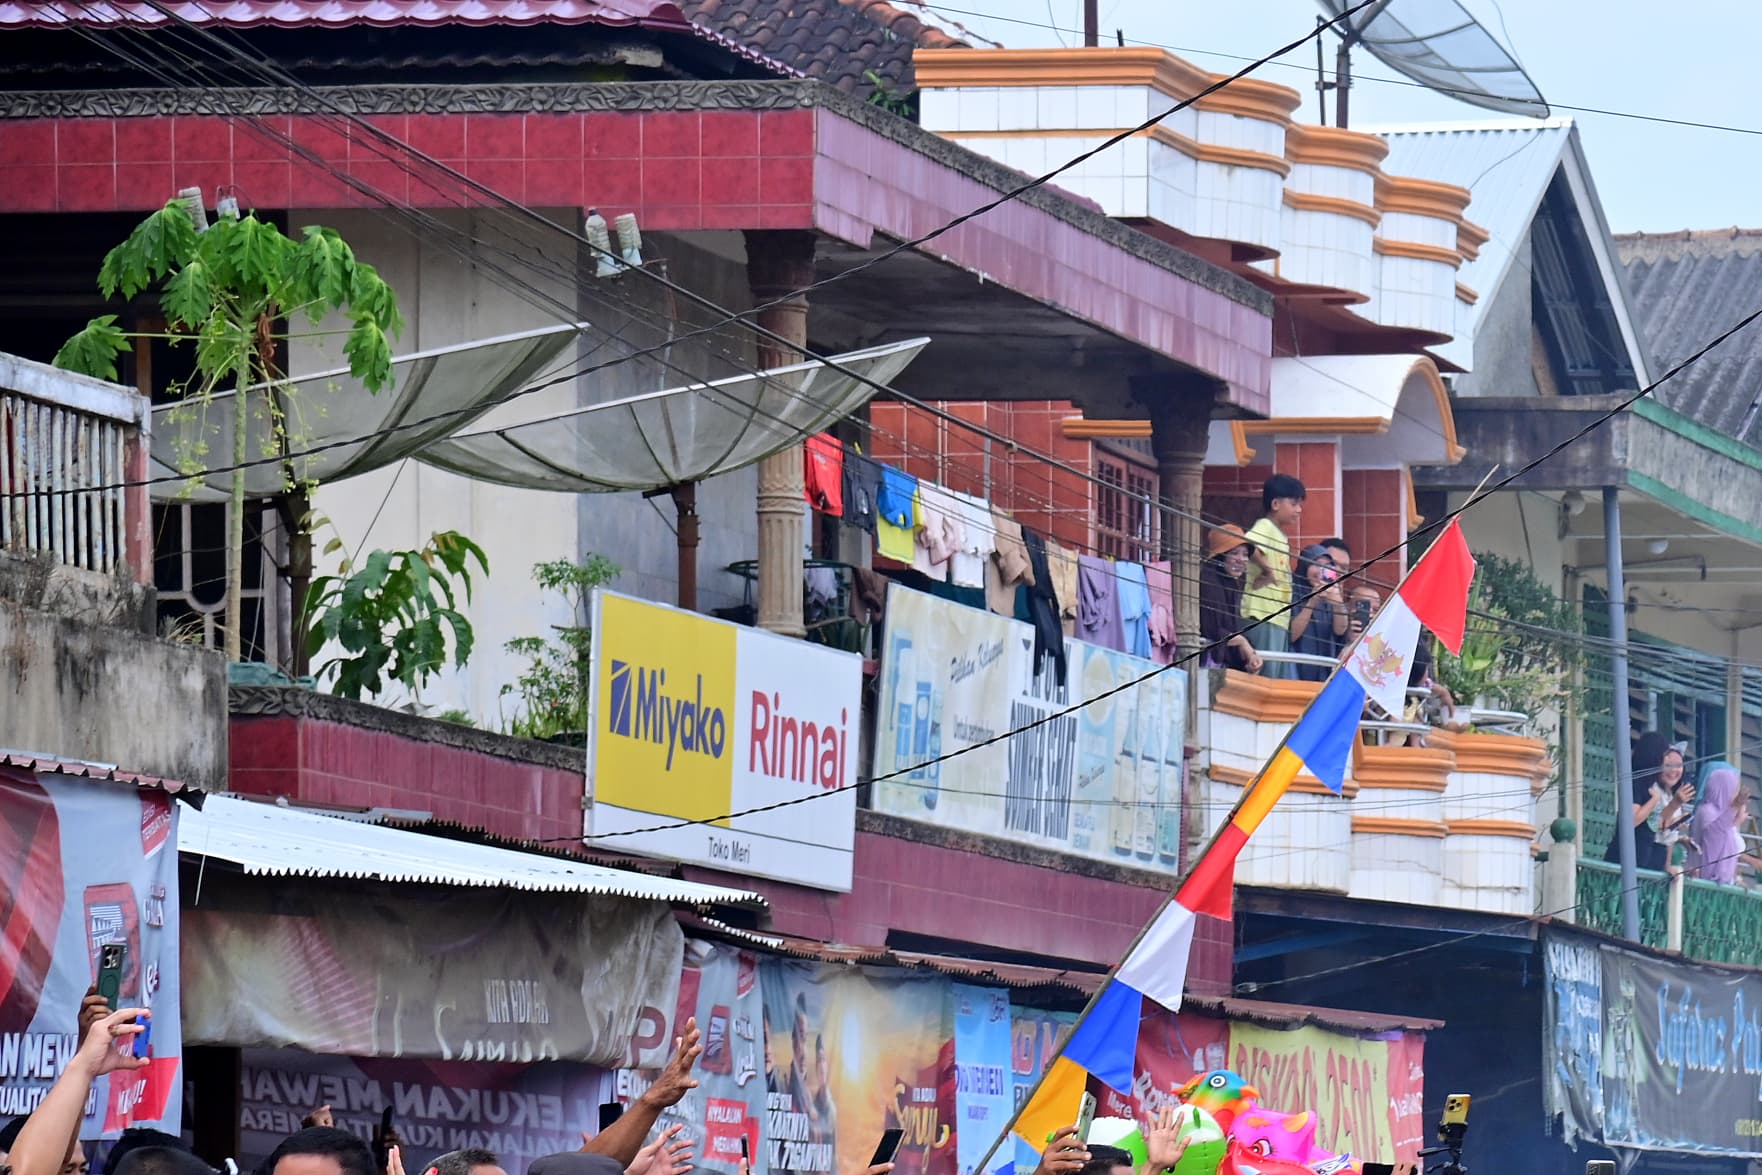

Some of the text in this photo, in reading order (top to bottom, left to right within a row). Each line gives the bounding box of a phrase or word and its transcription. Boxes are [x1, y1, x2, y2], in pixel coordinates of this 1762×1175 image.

[635, 665, 725, 770] Miyako
[749, 689, 848, 790] Rinnai
[708, 834, 751, 864] Toko Meri
[22, 1032, 80, 1078] MEW
